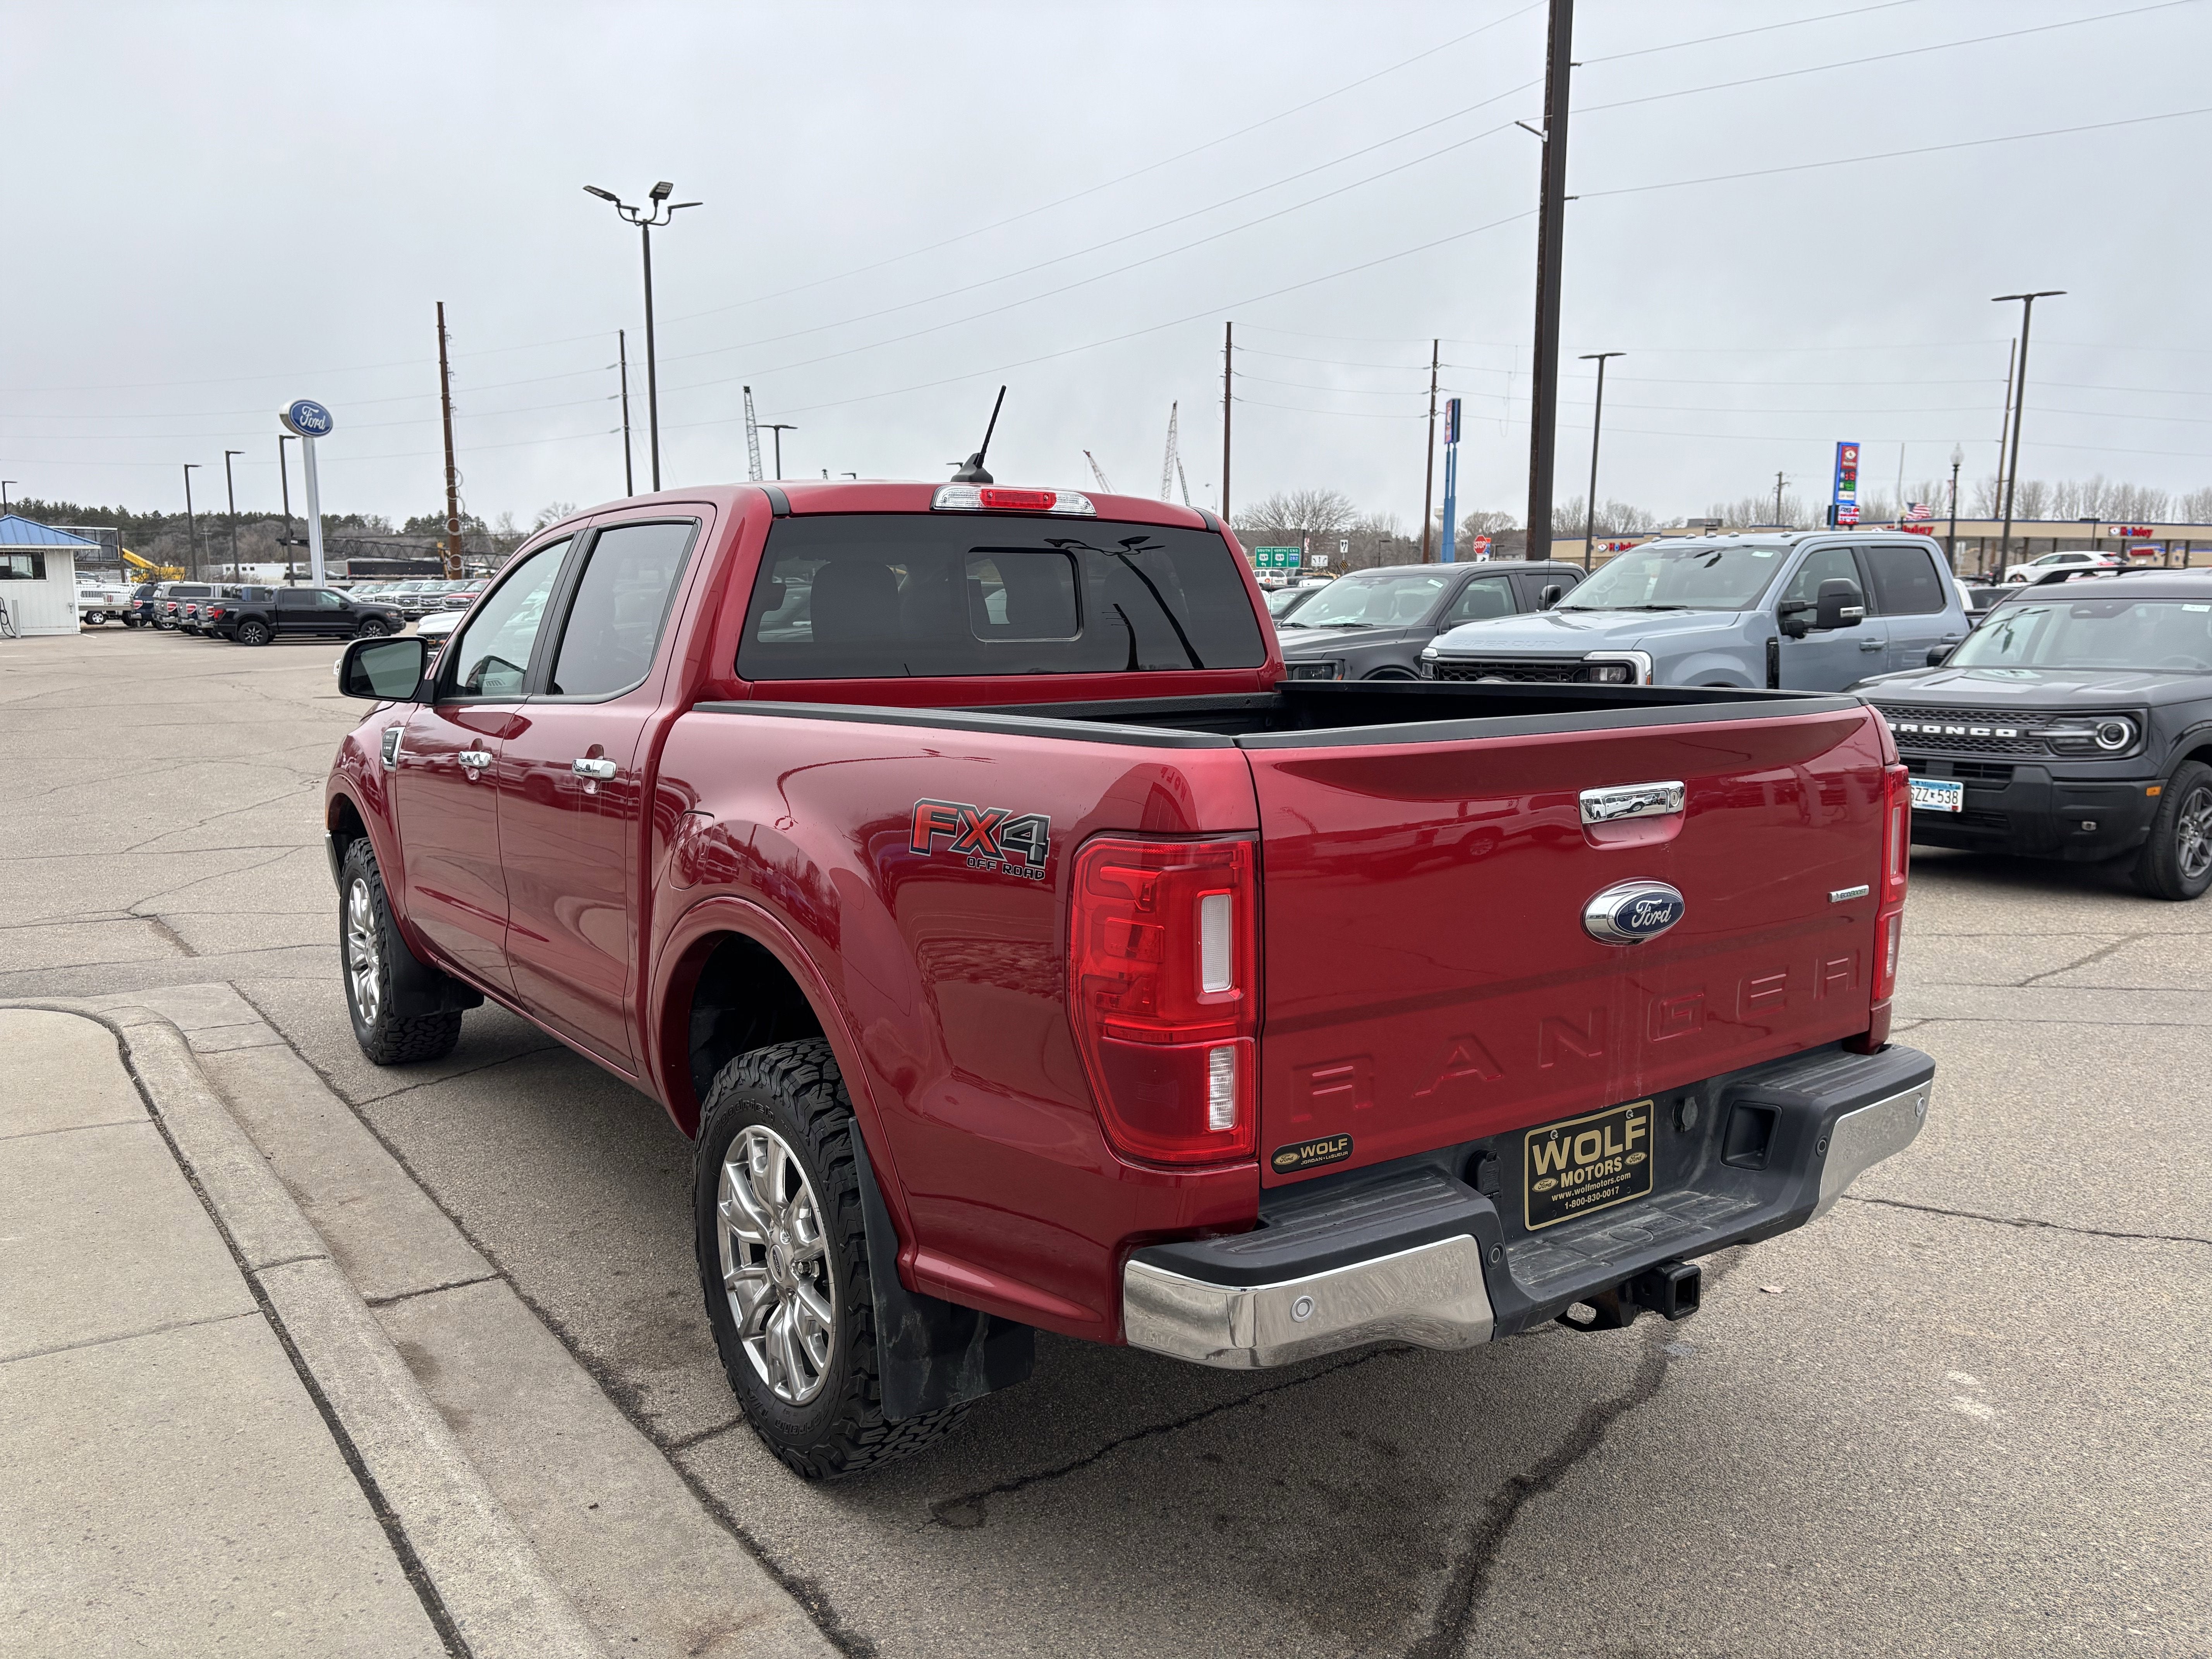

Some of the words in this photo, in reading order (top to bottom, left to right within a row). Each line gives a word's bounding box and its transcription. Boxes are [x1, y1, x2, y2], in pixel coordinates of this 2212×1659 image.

[300, 405, 326, 430] Ford
[1474, 541, 1486, 549] STOP
[1937, 789, 1958, 804] 538
[909, 797, 1051, 869] FX4
[967, 856, 997, 871] OFF
[1002, 862, 1045, 881] ROAD
[1840, 888, 1867, 899] ECOBOOST
[1631, 898, 1673, 928] Ford
[1291, 948, 1859, 1122] RANGER
[1300, 1138, 1348, 1158] WOLF
[1532, 1115, 1647, 1176] WOLF
[1279, 1155, 1294, 1163] Ford
[1300, 1156, 1323, 1165] JORDAN
[1630, 1154, 1643, 1163] Ford
[1561, 1156, 1622, 1188] MOTORS
[1538, 1182, 1553, 1190] Ford
[1552, 1172, 1631, 1201] www.wolfmotors.com
[1565, 1186, 1620, 1210] 1-800-830-0017
